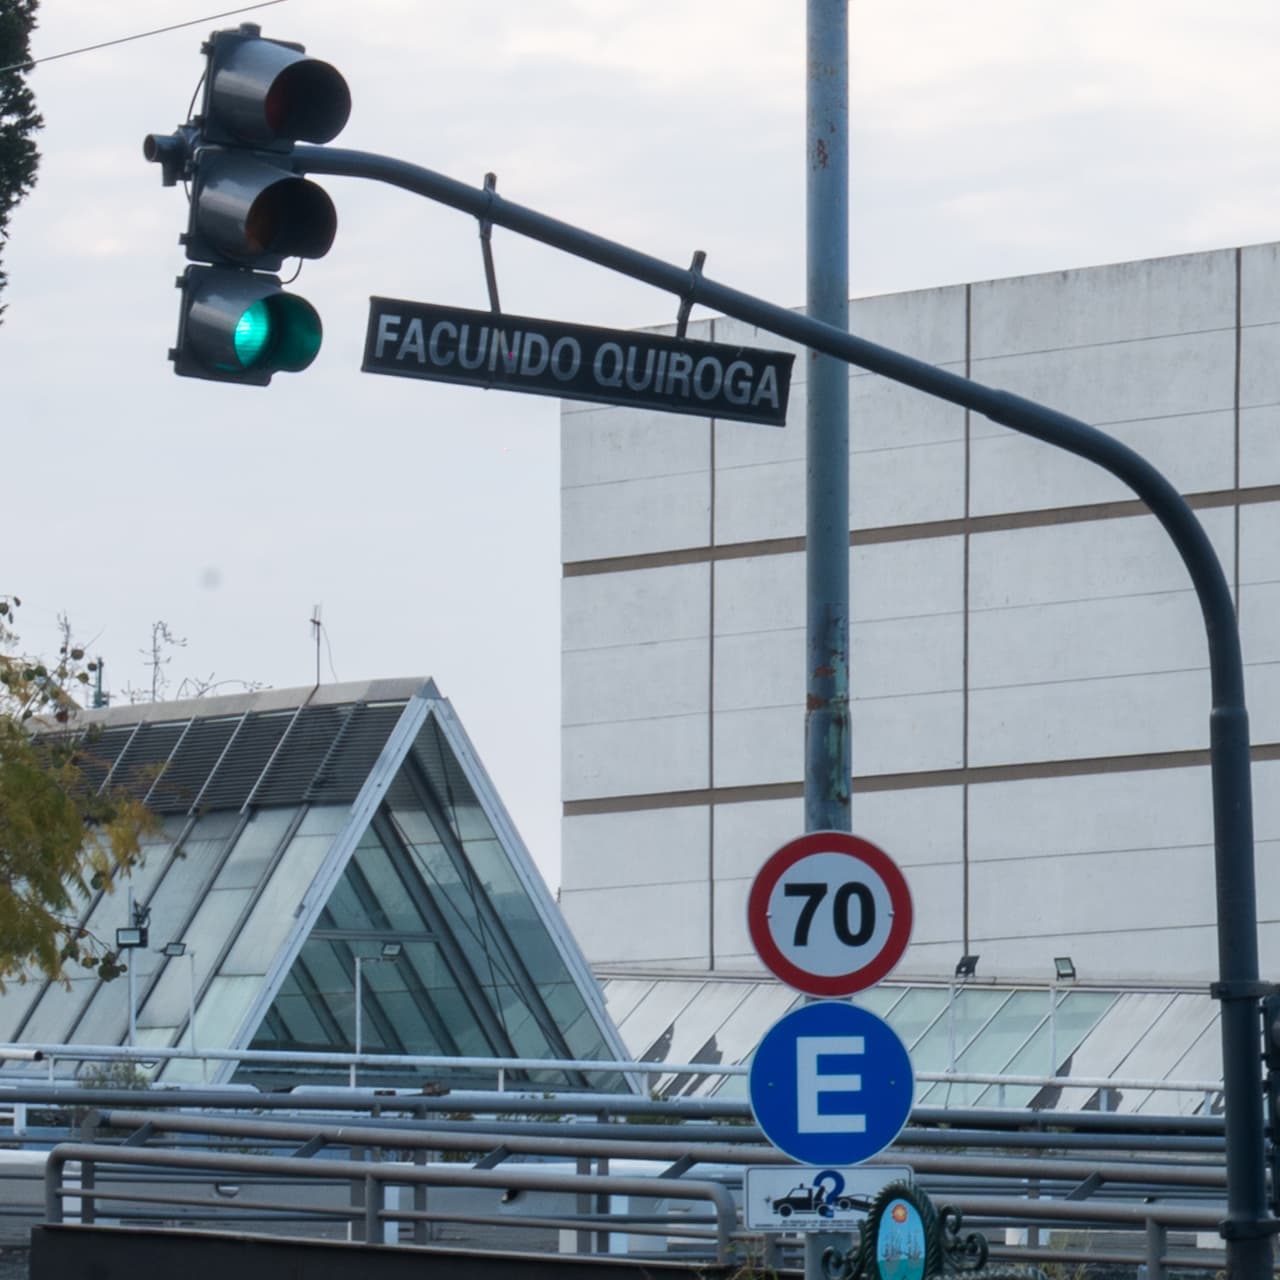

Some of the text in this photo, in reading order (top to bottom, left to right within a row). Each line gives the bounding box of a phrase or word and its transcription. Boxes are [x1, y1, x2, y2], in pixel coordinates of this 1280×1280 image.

[375, 313, 780, 409] FACUNDO QUIROGA
[784, 882, 876, 947] 70
[796, 1036, 867, 1134] E
